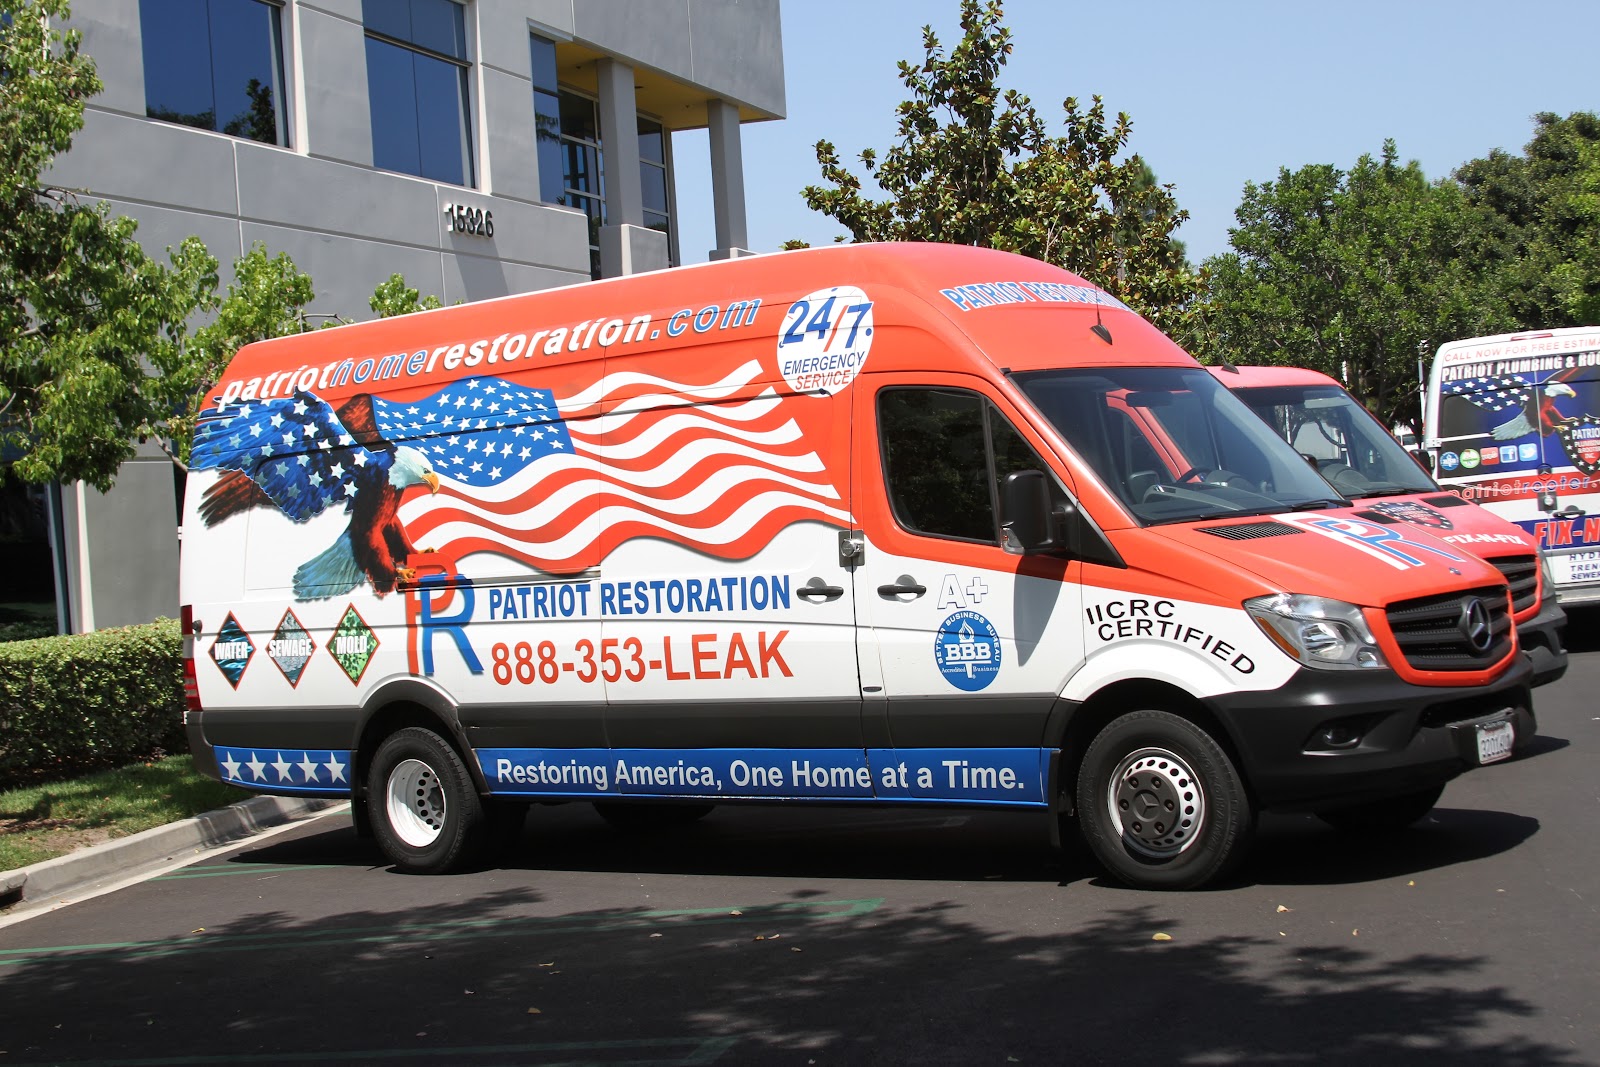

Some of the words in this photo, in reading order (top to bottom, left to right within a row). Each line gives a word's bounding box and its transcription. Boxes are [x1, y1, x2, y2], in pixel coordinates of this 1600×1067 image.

[444, 203, 494, 238] 15326
[939, 282, 1036, 311] PATRIOT
[783, 351, 865, 376] EMERGENCY
[1444, 351, 1472, 362] CALL
[1476, 348, 1501, 358] NOW
[1505, 346, 1527, 355] FOR
[1532, 342, 1560, 351] FREE
[795, 368, 850, 390] SERVICE
[1442, 362, 1494, 382] PATRIOT
[1497, 355, 1562, 375] PLUMBING
[1565, 355, 1576, 368] &
[1569, 550, 1600, 561] HYD
[1570, 562, 1600, 572] TREN
[489, 584, 592, 620] PATRIOT
[601, 575, 791, 616] RESTORATION
[937, 574, 988, 610] A+
[1086, 599, 1175, 625] IICRC
[214, 641, 249, 660] WATER
[269, 639, 312, 657] SEWAGE
[336, 636, 368, 654] MOLD
[935, 627, 946, 664] BETTER
[945, 611, 985, 626] BUSINESS
[985, 623, 1001, 662] BUREAU
[1098, 618, 1256, 675] CERTIFIED
[491, 630, 794, 686] 888-353-LEAK
[944, 642, 992, 661] BBB
[497, 759, 608, 790] Restoring
[615, 759, 722, 790] America,
[729, 760, 784, 787] One
[791, 760, 871, 788] Home
[881, 762, 908, 788] at
[916, 766, 933, 789] a
[942, 760, 1025, 789] Time.
